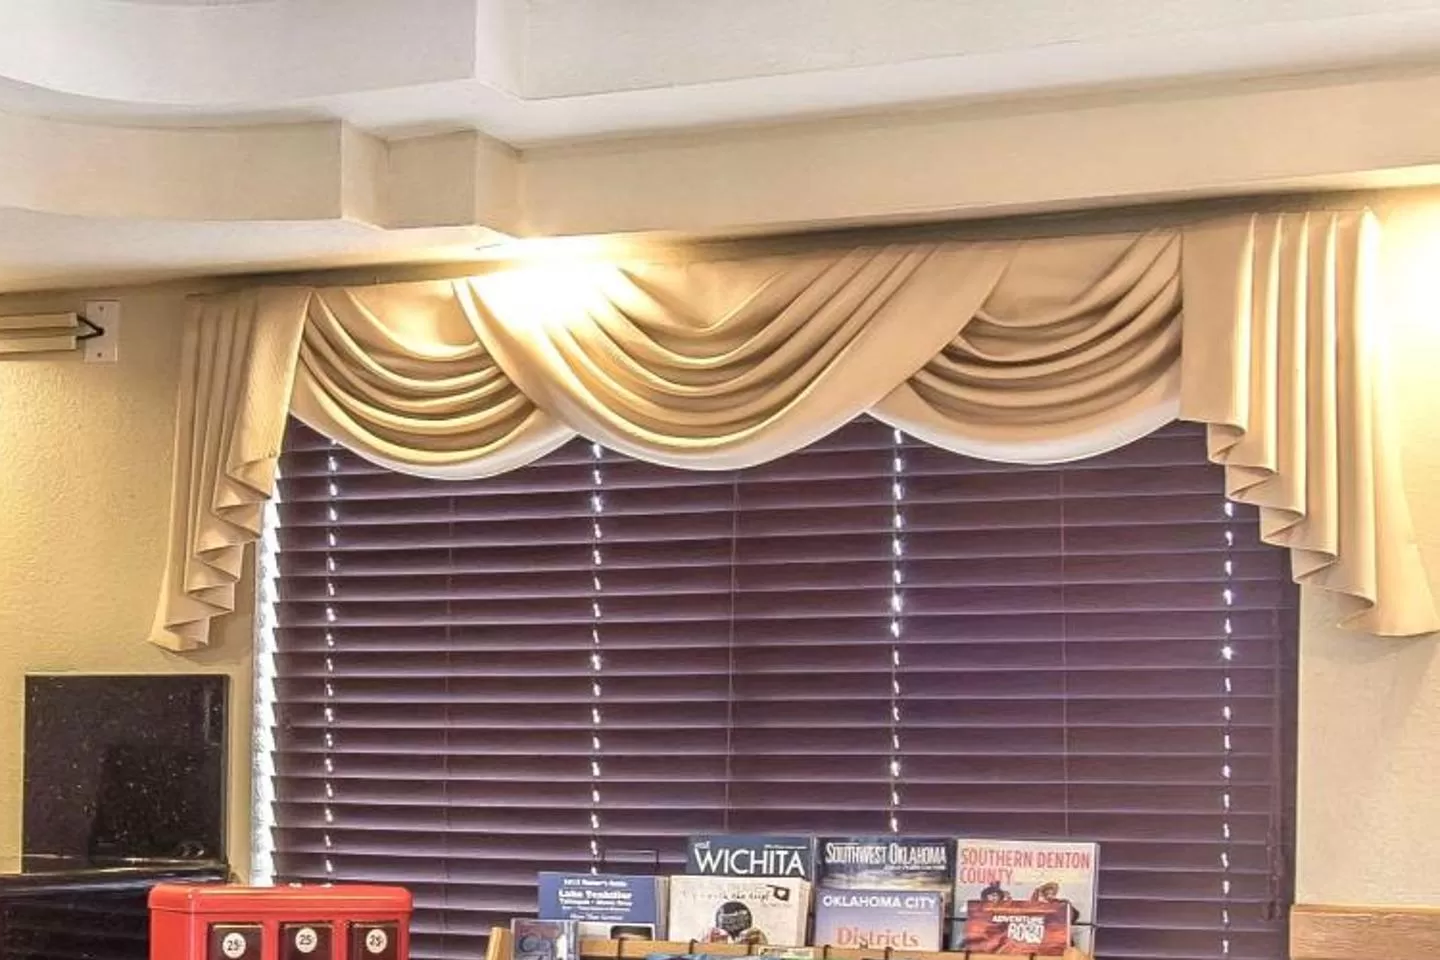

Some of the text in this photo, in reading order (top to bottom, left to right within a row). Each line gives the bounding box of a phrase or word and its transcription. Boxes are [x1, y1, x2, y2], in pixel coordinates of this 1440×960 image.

[694, 848, 806, 875] WICHITA
[825, 842, 947, 865] SOUTHWEST OKLAHOMA
[960, 847, 1091, 869] SOUTHERN DENTON
[960, 867, 1014, 884] COUNTY
[822, 895, 937, 909] OKLAHOMA CITY
[835, 926, 920, 947] Districts
